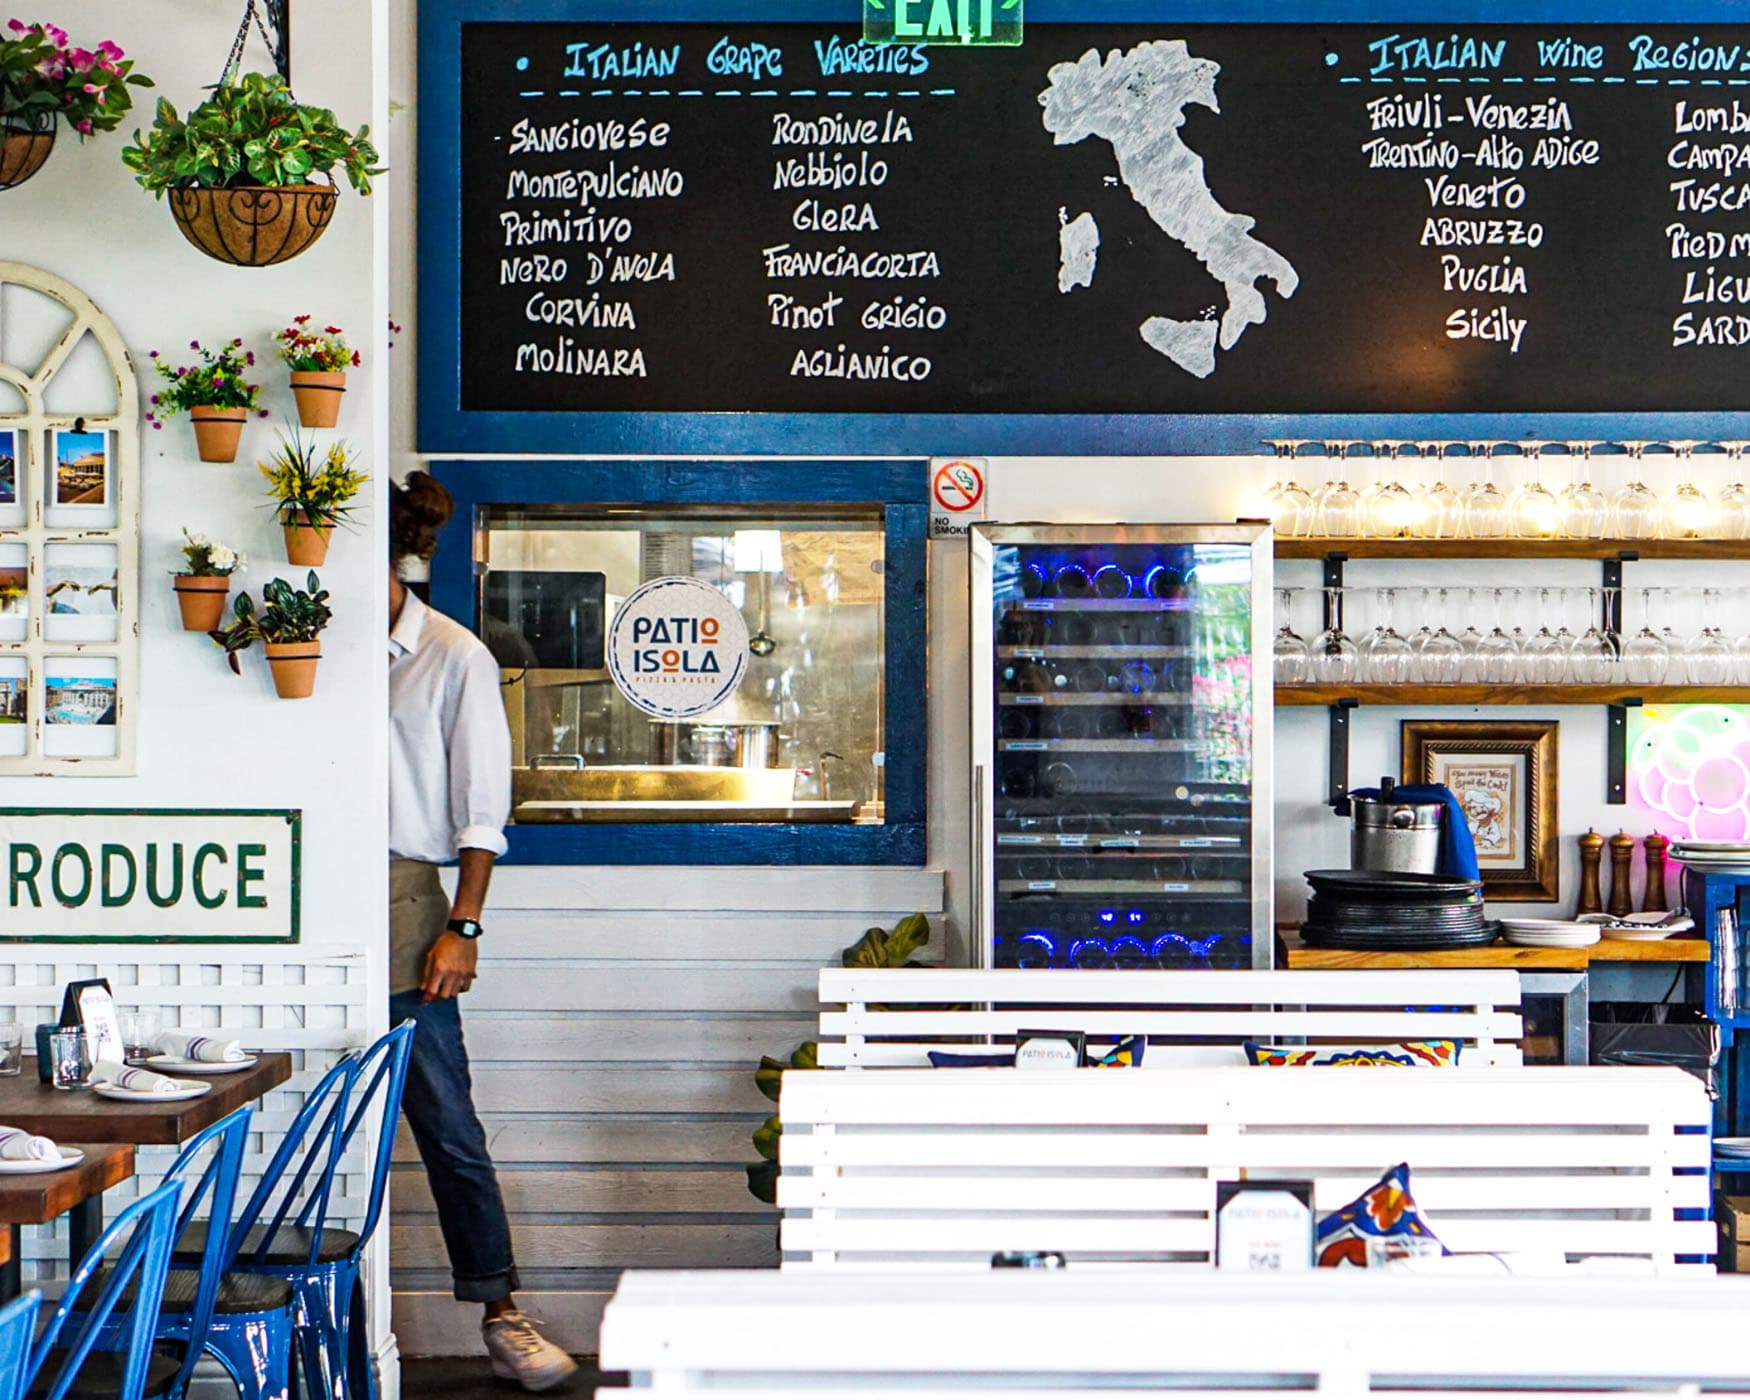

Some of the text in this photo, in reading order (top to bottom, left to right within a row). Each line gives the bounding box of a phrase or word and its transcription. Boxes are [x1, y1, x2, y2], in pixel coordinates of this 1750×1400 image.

[1676, 101, 1750, 134] Lomb
[1445, 306, 1528, 352] Sicily
[934, 526, 968, 534] SMOKI
[633, 617, 719, 644] PATIO
[634, 650, 720, 673] ISOLA
[9, 842, 268, 909] RODUCE
